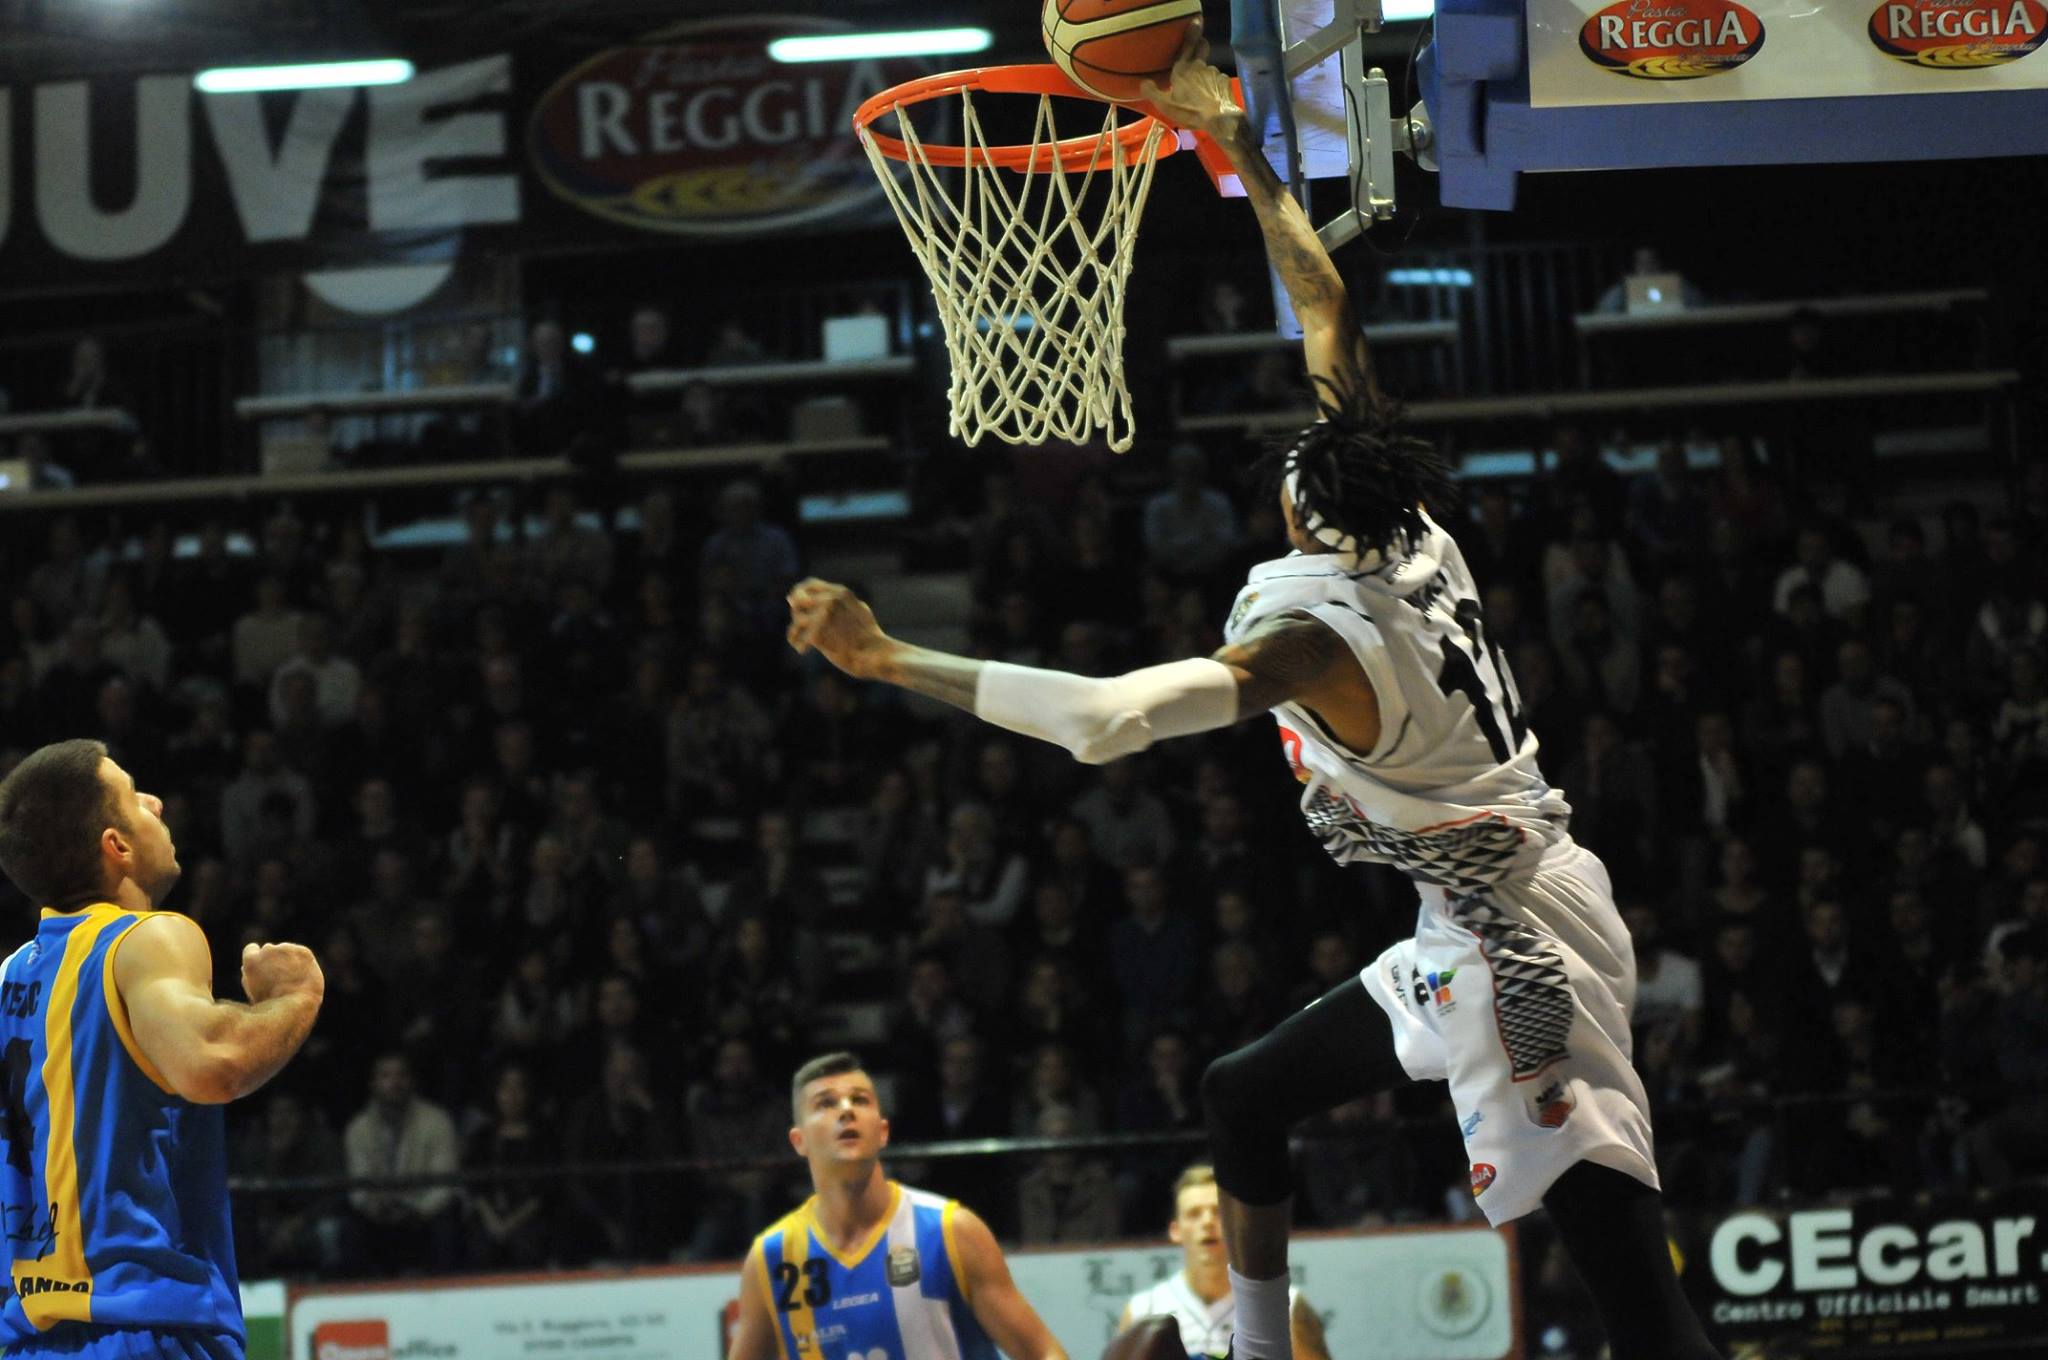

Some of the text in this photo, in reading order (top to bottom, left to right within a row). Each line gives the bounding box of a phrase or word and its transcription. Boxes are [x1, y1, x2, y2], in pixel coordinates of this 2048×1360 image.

[1599, 10, 1748, 50] REGGIA
[1888, 1, 2036, 39] REGGIA
[576, 56, 897, 160] REGGIA
[0, 54, 521, 262] UVE
[775, 1257, 831, 1313] 23
[1712, 1302, 1804, 1323] Centro
